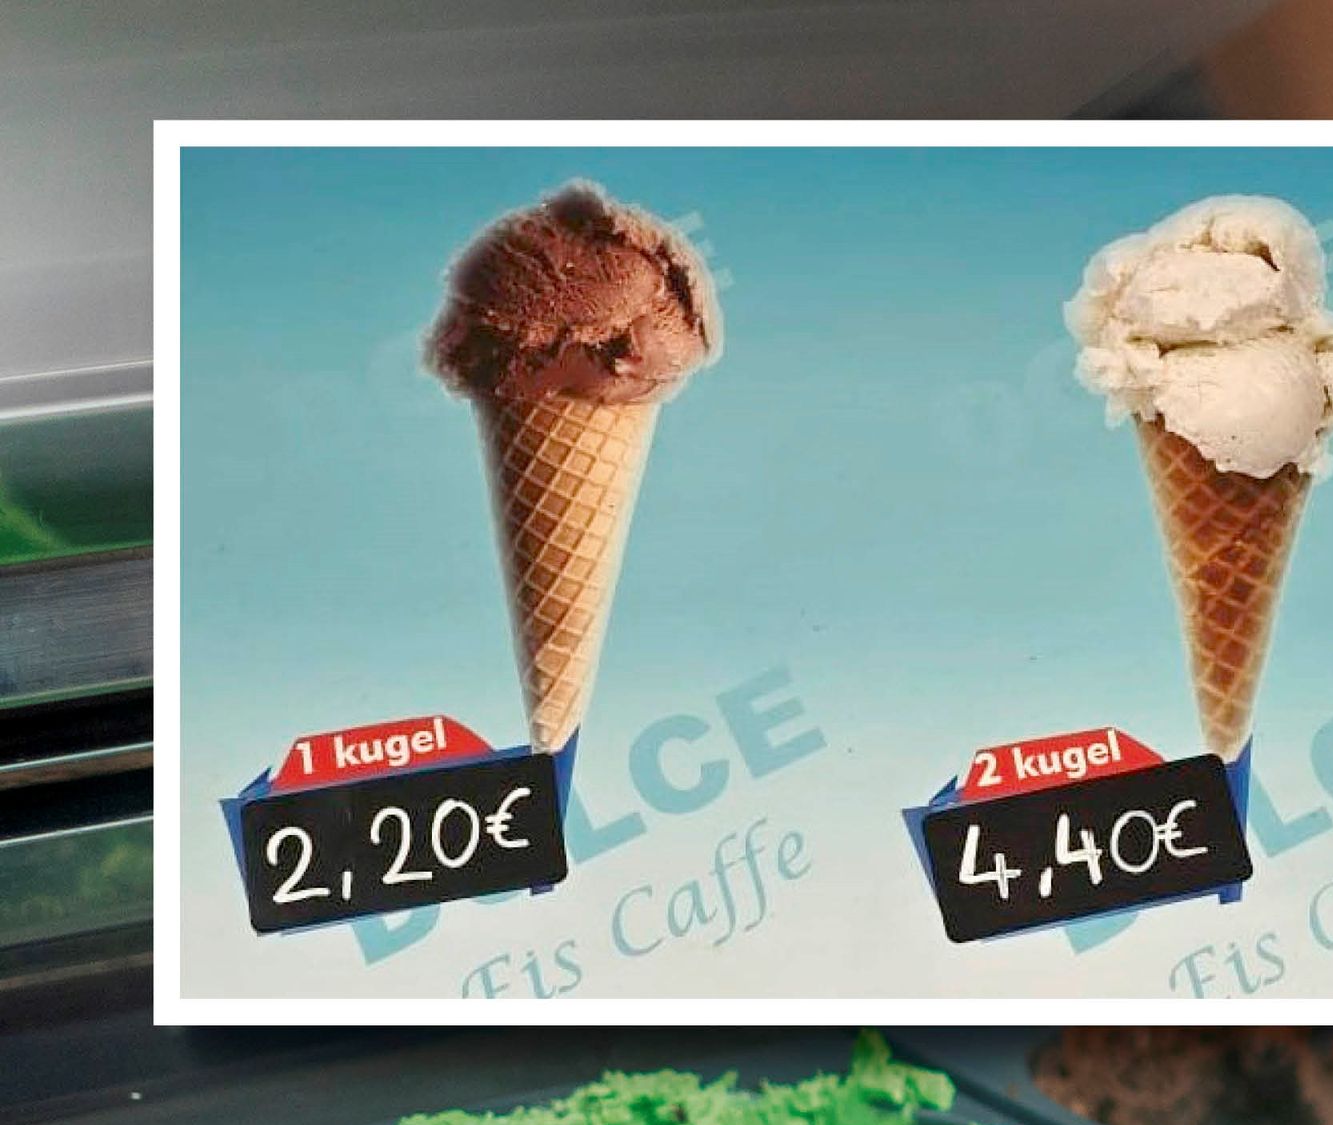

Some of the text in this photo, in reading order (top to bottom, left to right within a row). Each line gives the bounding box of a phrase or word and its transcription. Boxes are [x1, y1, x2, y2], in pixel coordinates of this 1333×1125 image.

[295, 717, 447, 775] 1 kugel
[974, 727, 1121, 787] 2 kugel
[266, 787, 531, 904] 2,20€
[610, 818, 812, 957] Caffe
[958, 799, 1208, 899] 4,40€
